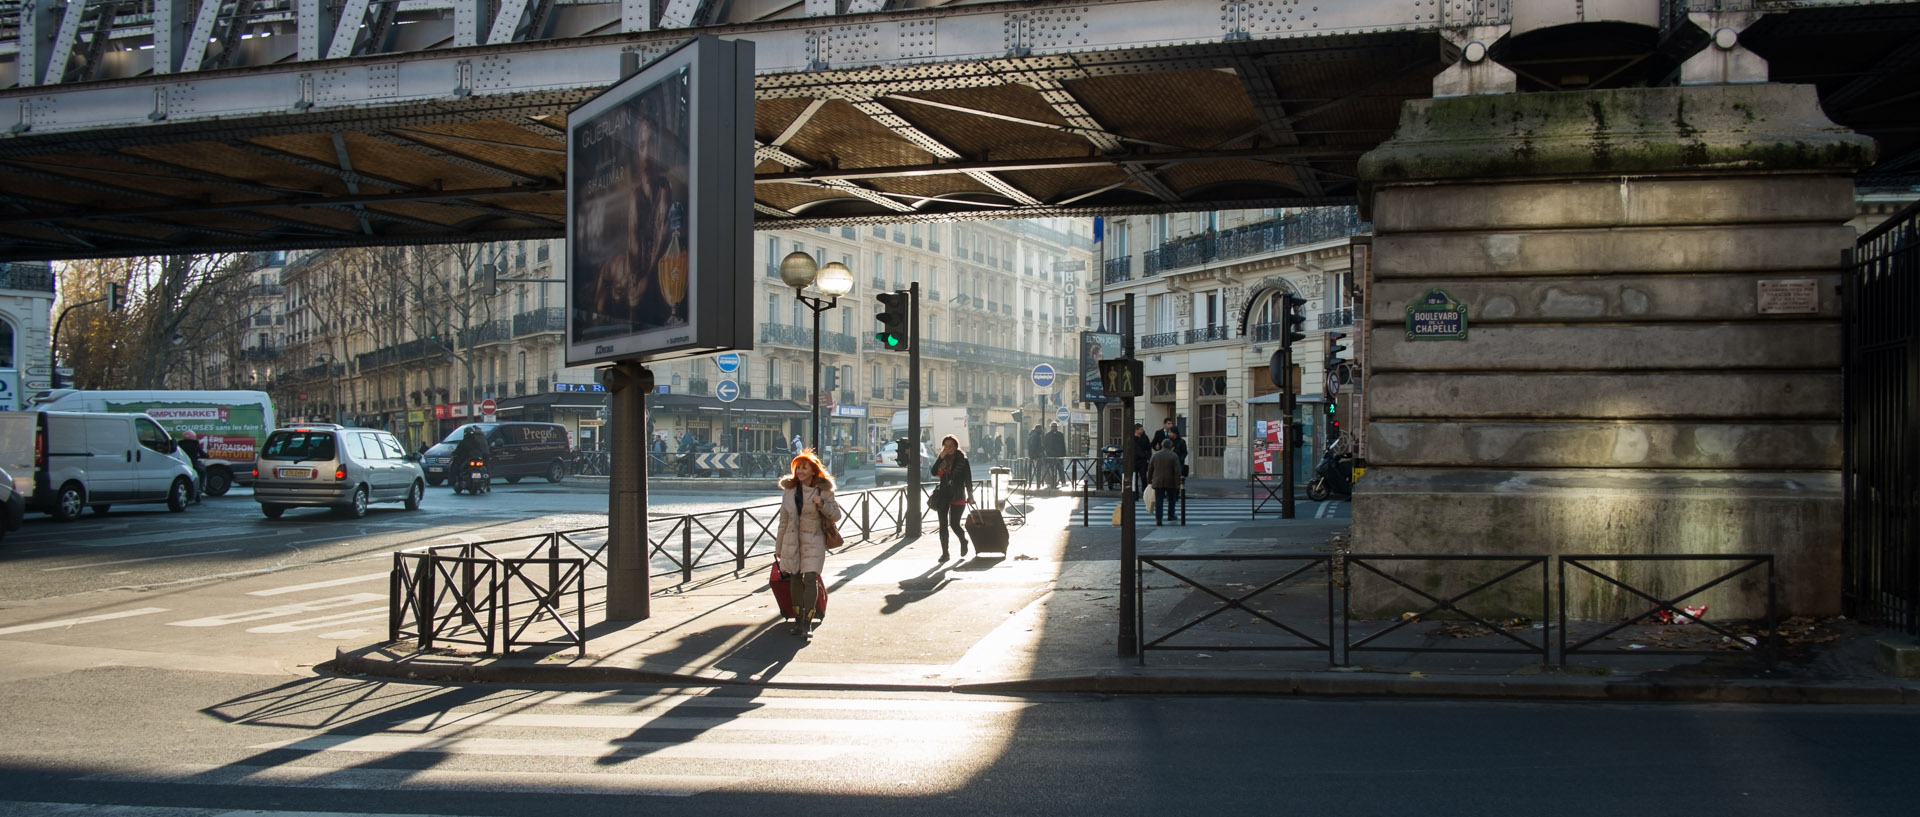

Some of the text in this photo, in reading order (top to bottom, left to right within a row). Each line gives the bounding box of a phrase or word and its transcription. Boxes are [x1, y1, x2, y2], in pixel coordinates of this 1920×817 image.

[582, 110, 631, 148] GUERLAIN
[587, 166, 624, 194] SHALIMAR
[1065, 272, 1075, 328] HOTEL
[1415, 312, 1458, 321] BOULEVARD
[1415, 325, 1458, 333] CHAPELLE
[1086, 335, 1120, 345] ELTON JOHN
[569, 384, 586, 392] LA
[175, 424, 214, 432] COURSES
